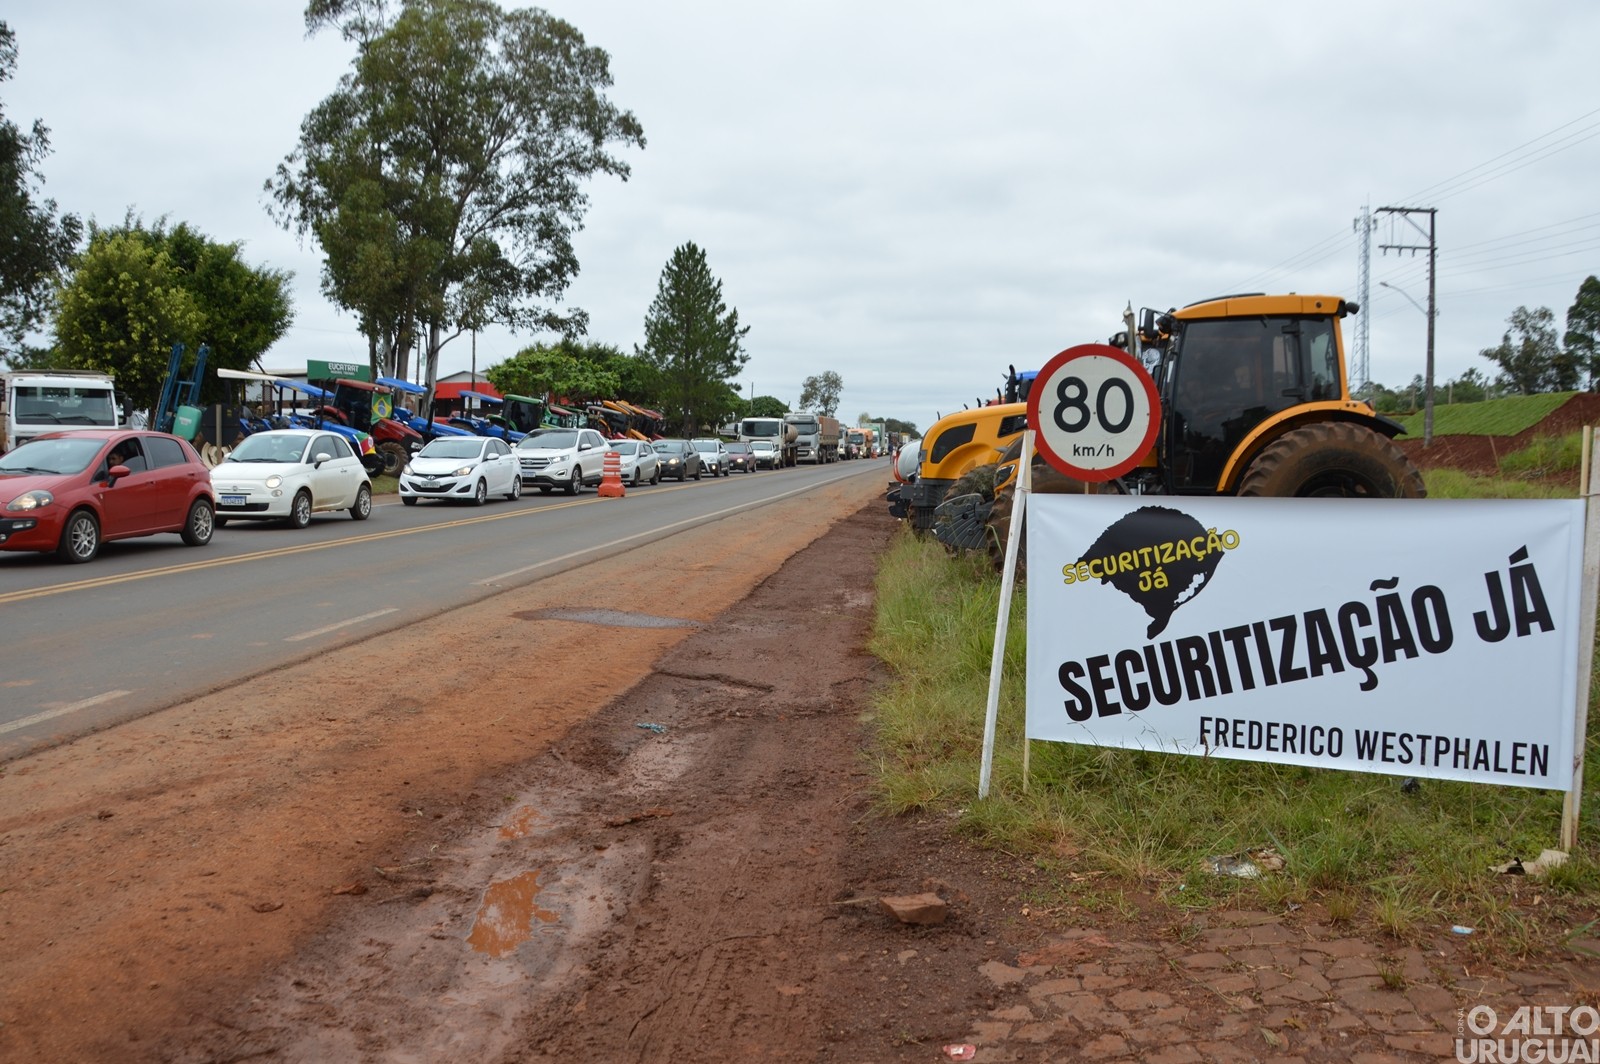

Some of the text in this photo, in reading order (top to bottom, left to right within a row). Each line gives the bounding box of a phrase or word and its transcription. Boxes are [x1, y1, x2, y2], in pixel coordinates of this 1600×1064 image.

[328, 362, 359, 372] EUCATRAT
[1054, 376, 1134, 433] 80
[1073, 444, 1114, 456] km/h
[1062, 527, 1240, 584] SECURITIZAÇÃO
[1138, 566, 1169, 592] Já
[1058, 544, 1556, 722] SECURITIZAÇÃO JÁ
[1200, 716, 1549, 777] FREDERICO WESTPHALEN
